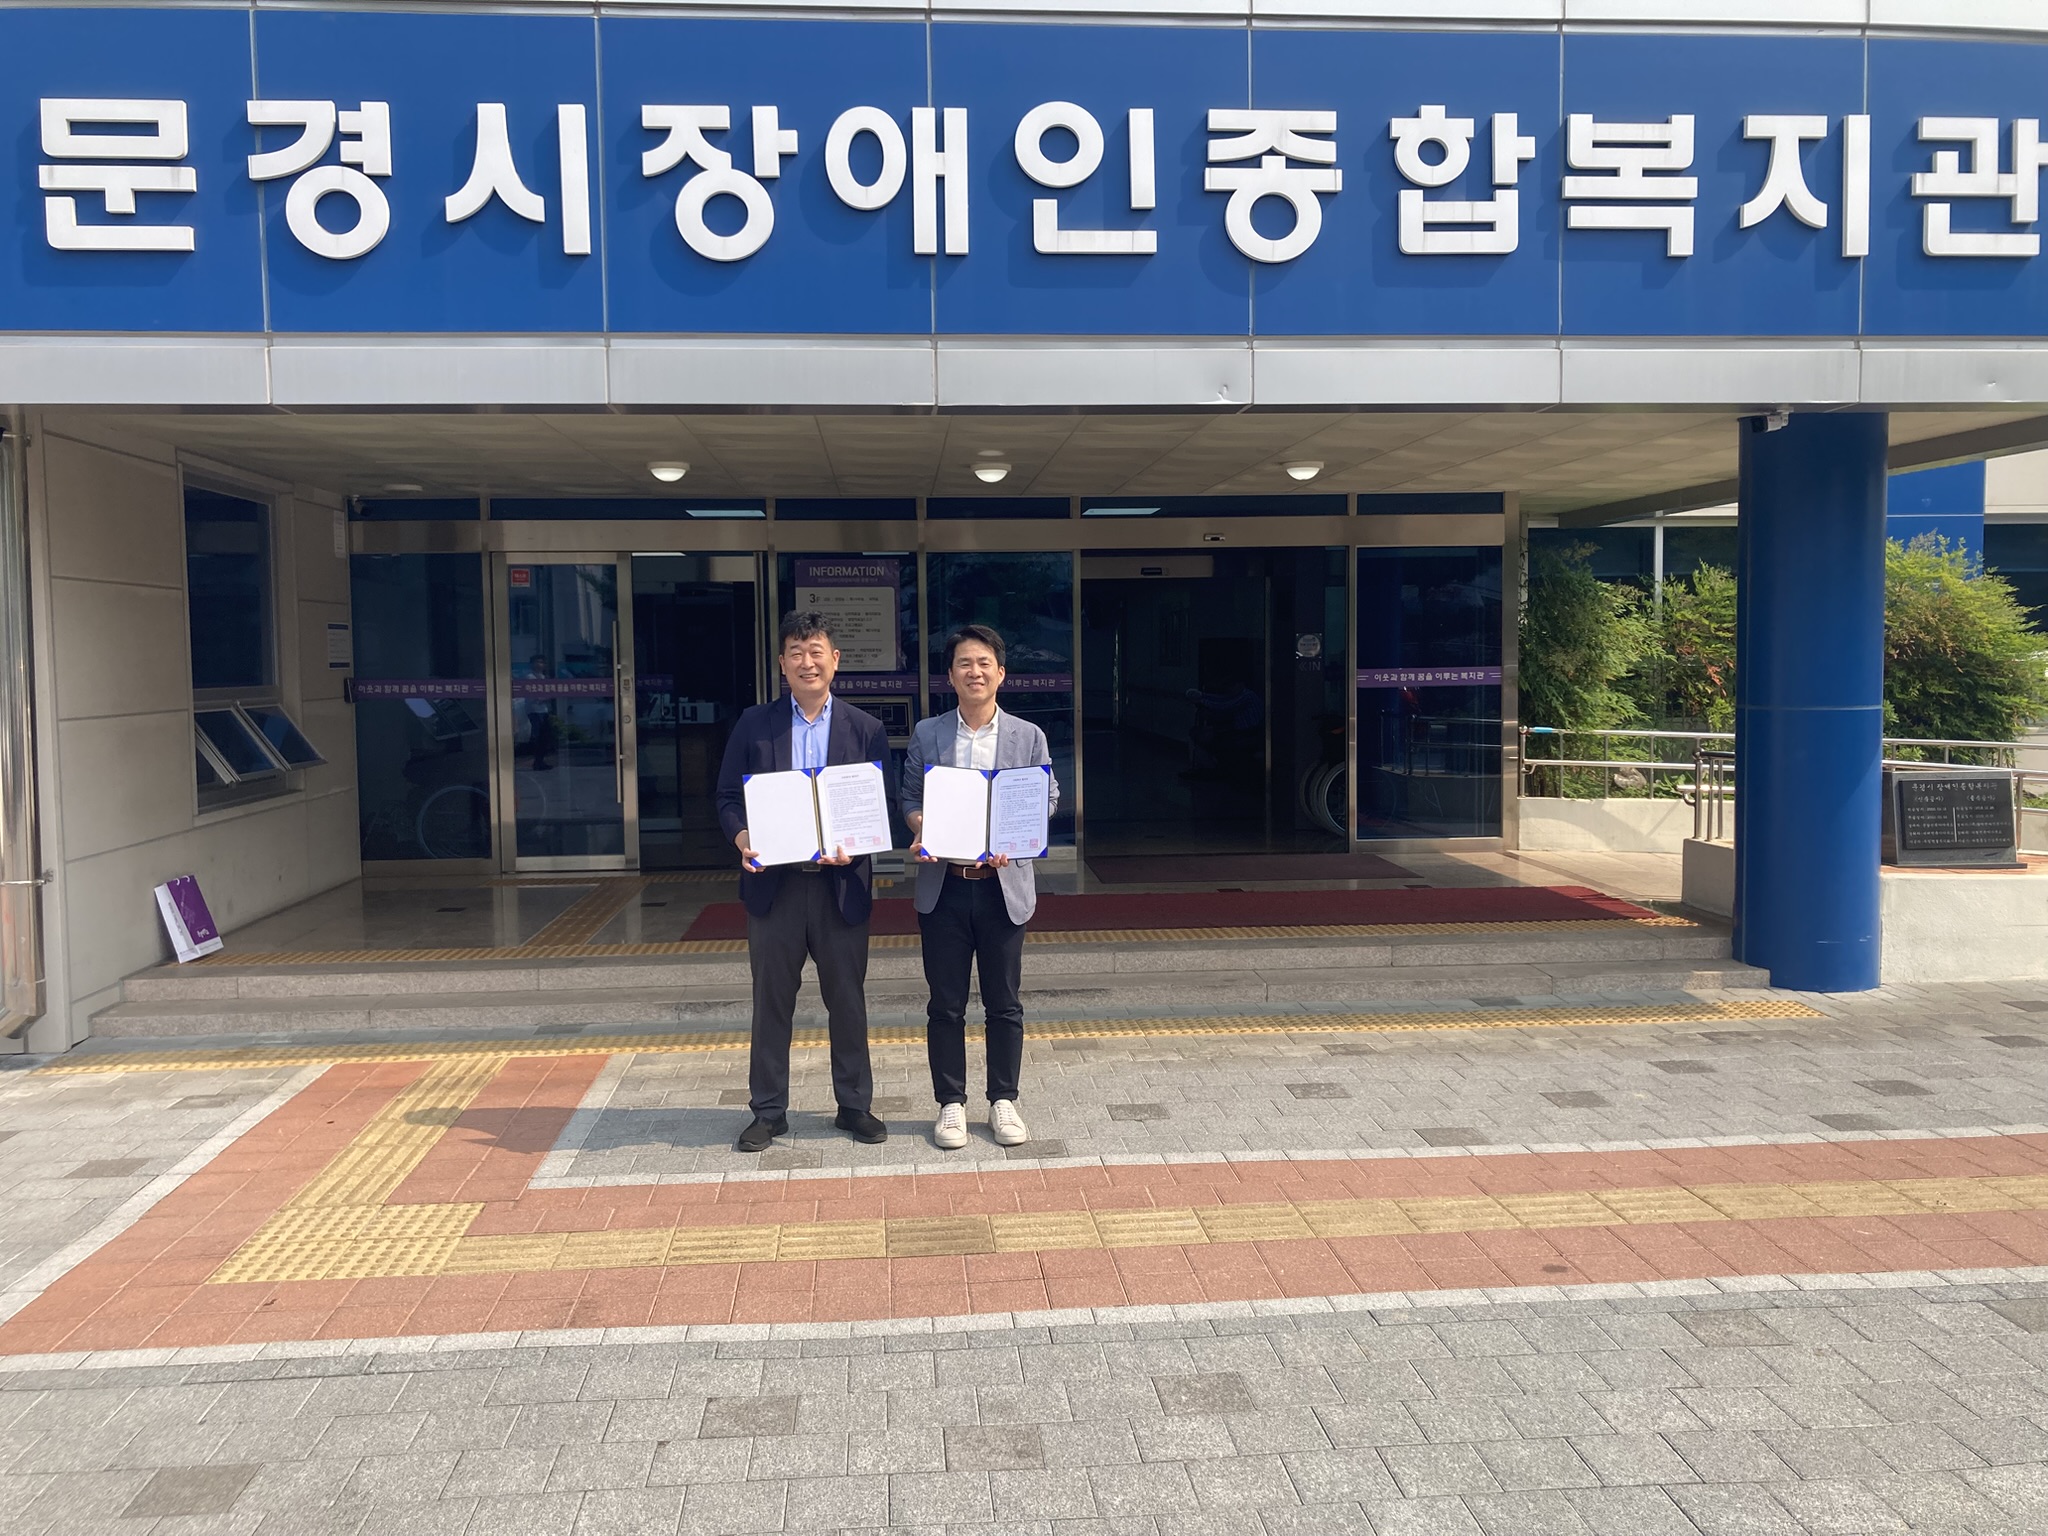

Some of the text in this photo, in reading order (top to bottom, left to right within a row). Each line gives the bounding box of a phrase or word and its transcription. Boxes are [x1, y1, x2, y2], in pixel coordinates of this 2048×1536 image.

[38, 97, 2048, 264] 문경시장애인종합복지관
[809, 566, 885, 577] INFORMATION
[809, 593, 820, 604] 3F
[1374, 673, 1398, 682] 이웃과
[1400, 673, 1415, 681] 함께
[1435, 672, 1458, 681] 이루는
[1460, 671, 1485, 680] 복지관
[855, 680, 878, 689] 이루는
[880, 680, 903, 689] 복지관
[1007, 679, 1030, 688] 이루는
[1032, 678, 1056, 688] 복지관
[419, 685, 443, 694] 이루는
[445, 685, 469, 694] 복지관
